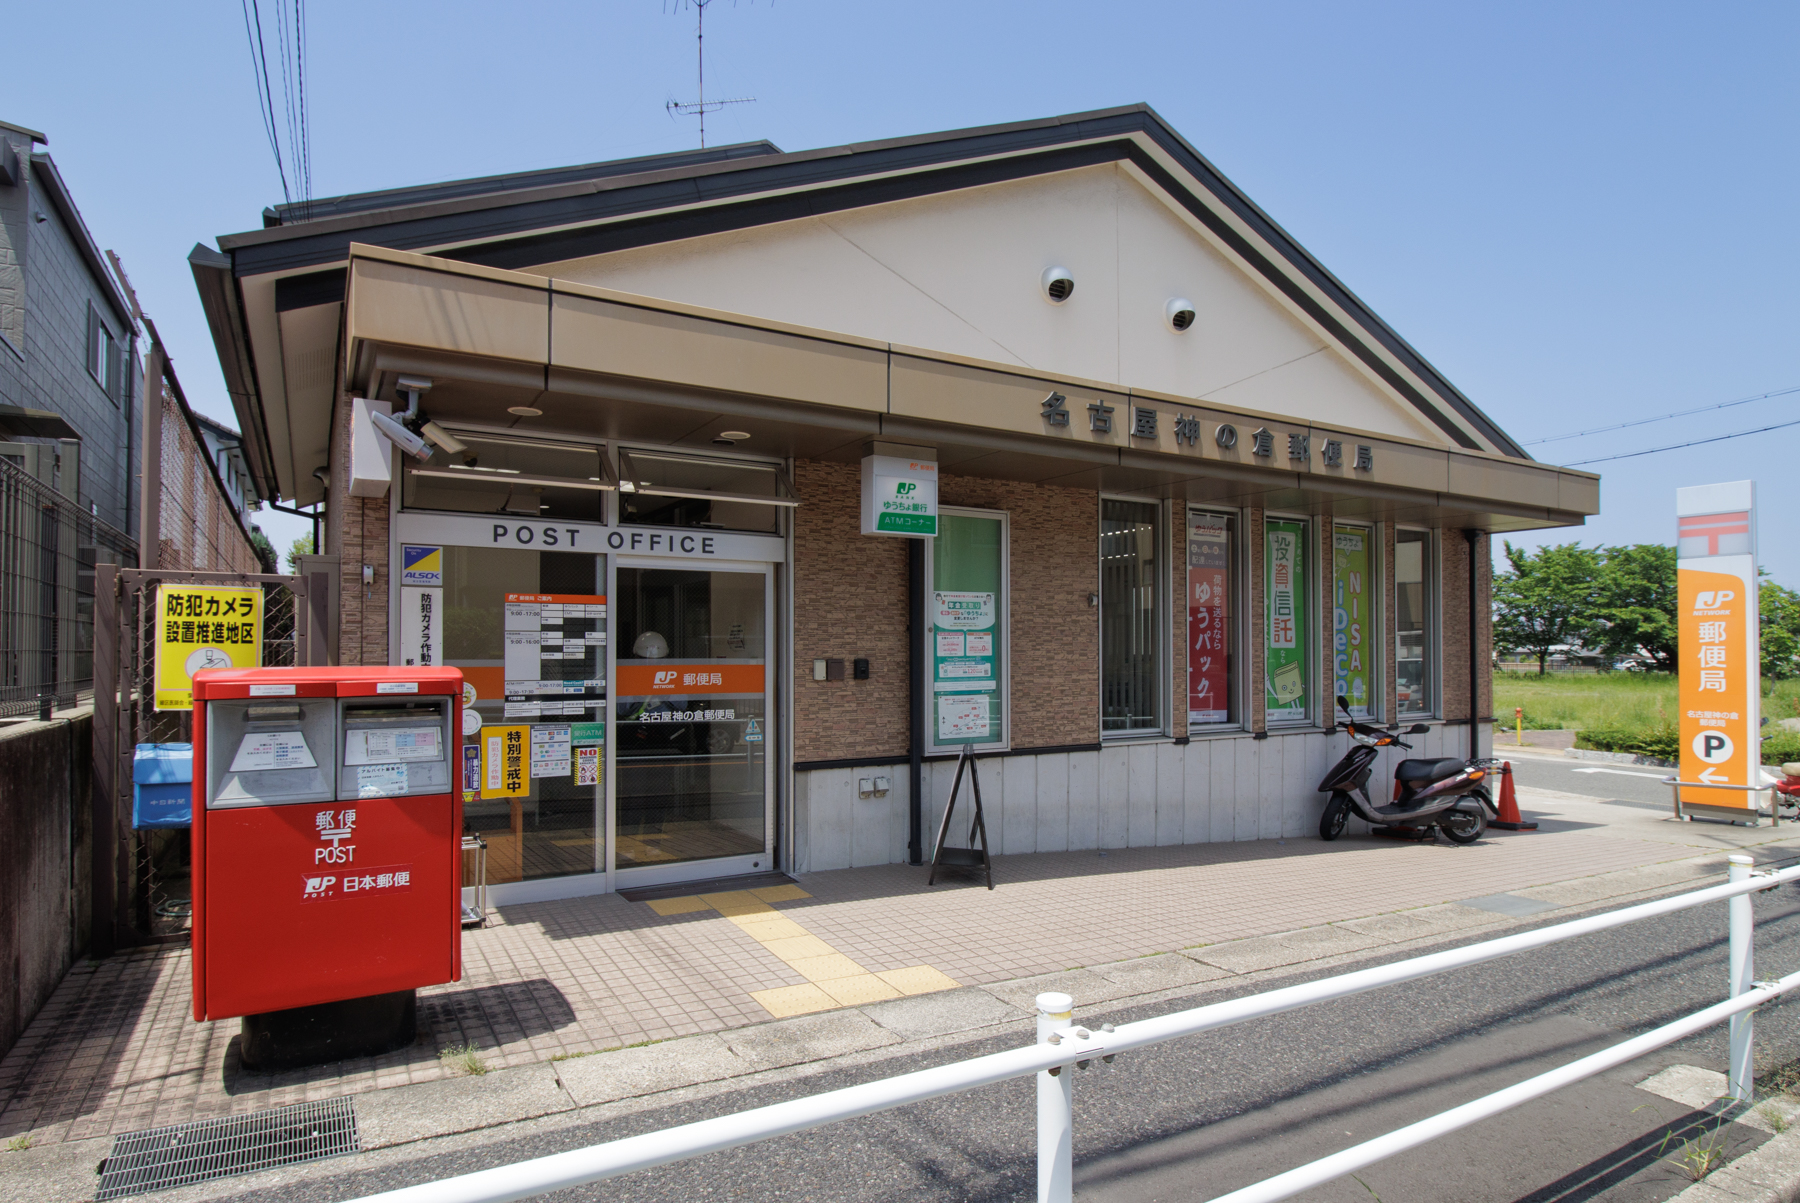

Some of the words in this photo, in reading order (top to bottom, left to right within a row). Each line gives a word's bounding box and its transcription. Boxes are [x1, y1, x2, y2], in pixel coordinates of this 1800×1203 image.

[1040, 391, 1374, 472] 名古屋神の倉郵便局
[883, 501, 928, 513] ゆうちょ銀行
[884, 516, 932, 526] ATMコーナー
[1194, 524, 1223, 535] ゆうパック
[493, 524, 580, 547] POST
[607, 531, 715, 554] OFFICE
[1336, 535, 1359, 549] ゆうちょ
[404, 571, 440, 580] ALSOK
[1273, 535, 1293, 644] 投資信託
[1695, 590, 1735, 609] JP
[166, 593, 254, 617] 防犯カメラ
[1212, 574, 1222, 650] 荷物を送るなら
[1349, 571, 1362, 672] NISA
[166, 620, 254, 644] 設置推進地区
[1195, 581, 1211, 699] ゆうパック
[1335, 579, 1349, 697] iDeCo
[1280, 650, 1286, 664] なら
[1697, 620, 1727, 693] 郵便局
[653, 671, 677, 685] JP
[683, 672, 722, 686] 郵便局
[639, 708, 735, 723] 名古屋神の倉郵便局
[1686, 709, 1739, 720] 名古屋神の倉
[1699, 718, 1727, 728] 郵便局
[579, 749, 597, 757] NO
[1704, 734, 1726, 758] P
[491, 740, 499, 787] 防犯カメラ作動中
[315, 809, 356, 830] 郵便
[315, 845, 356, 865] POST
[304, 876, 336, 893] JP
[343, 871, 410, 892] 日本郵便
[303, 891, 334, 899] POST
